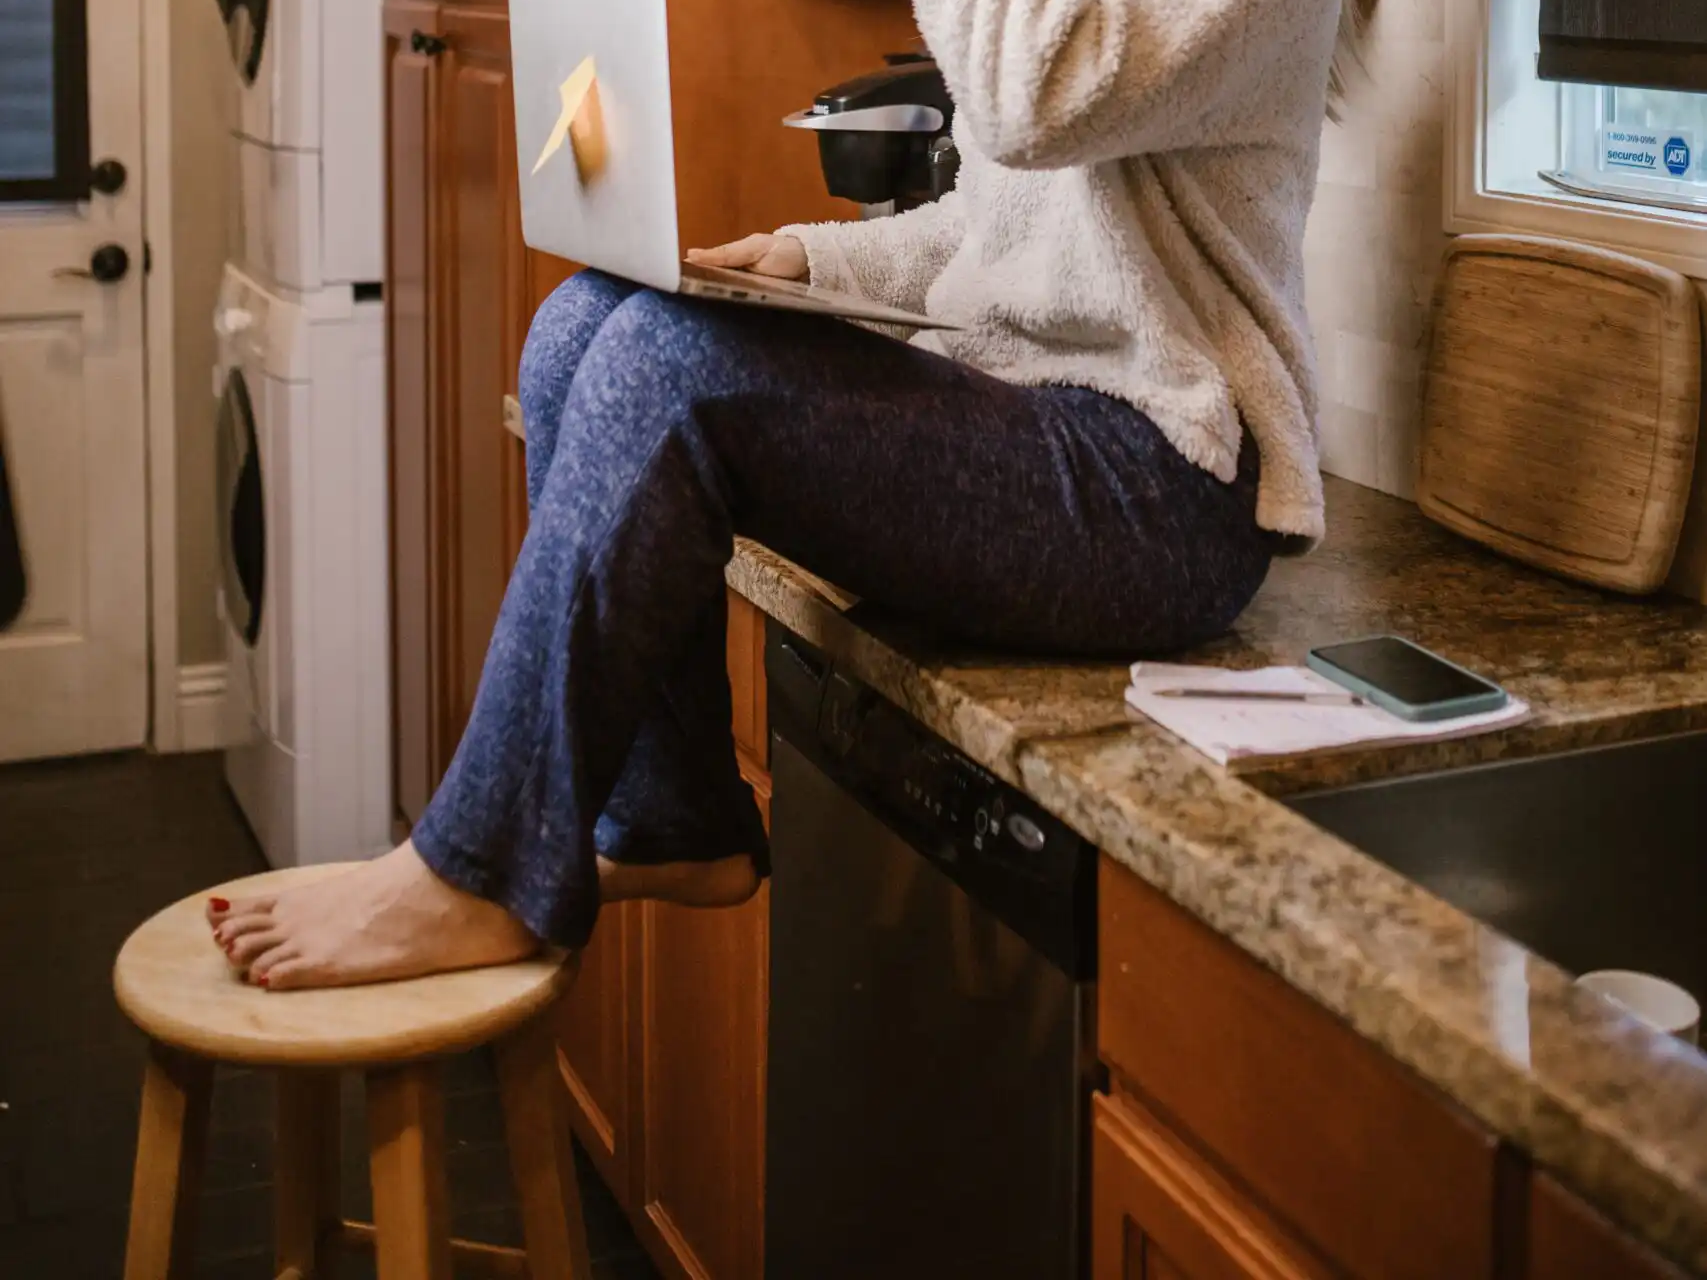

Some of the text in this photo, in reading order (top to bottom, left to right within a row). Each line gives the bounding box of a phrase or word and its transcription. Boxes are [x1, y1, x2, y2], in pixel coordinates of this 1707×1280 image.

[1607, 150, 1656, 165] secured by
[1667, 148, 1686, 163] ADT
